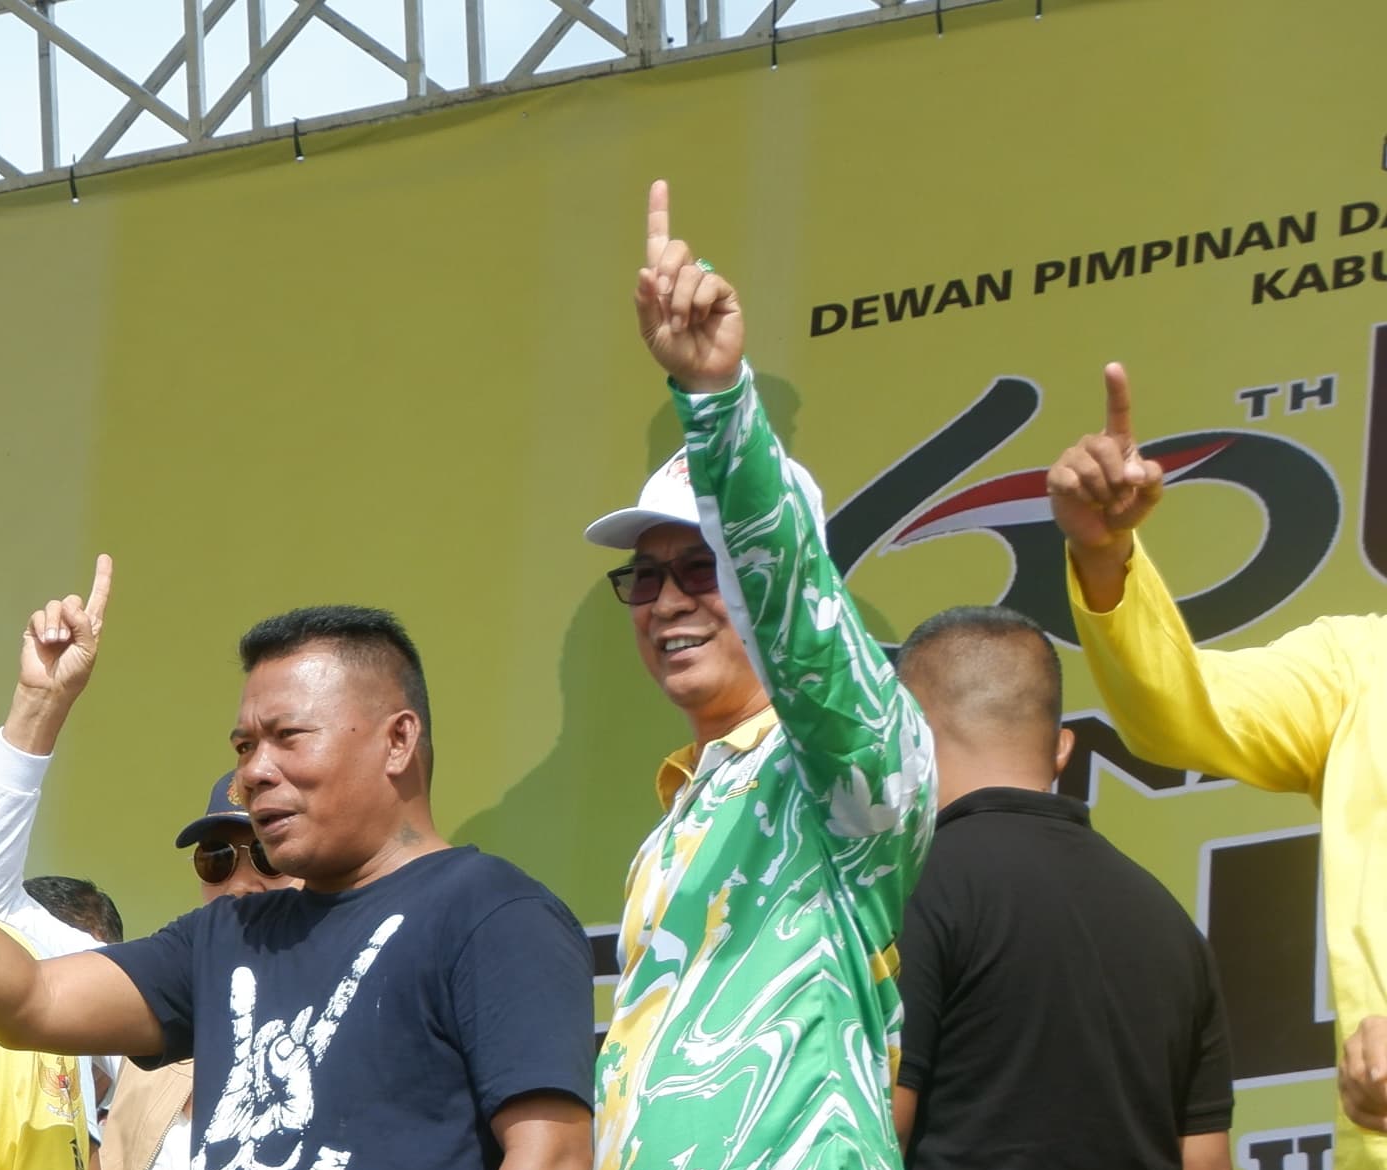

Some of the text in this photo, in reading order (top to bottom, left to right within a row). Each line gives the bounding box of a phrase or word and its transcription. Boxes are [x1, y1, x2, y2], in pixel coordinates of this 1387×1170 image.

[810, 201, 1387, 339] DEWAN PIMPINAN D
[1237, 373, 1337, 419] TH
